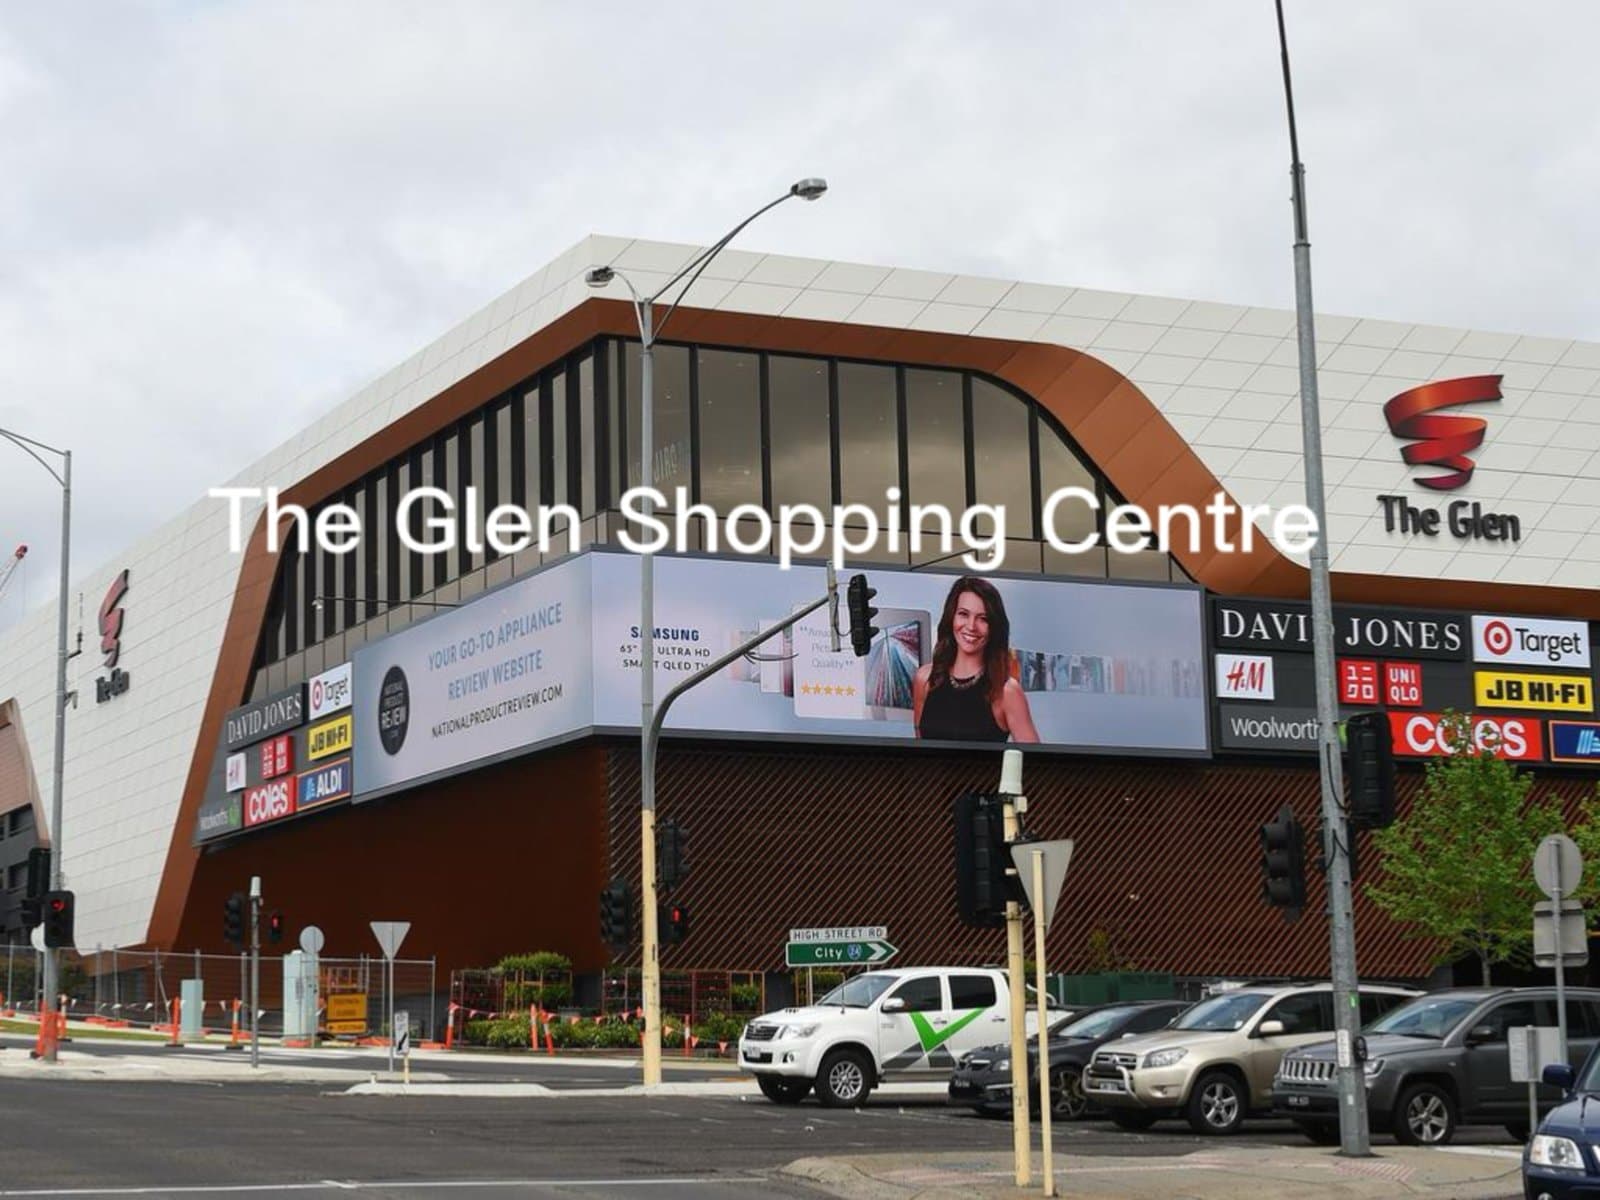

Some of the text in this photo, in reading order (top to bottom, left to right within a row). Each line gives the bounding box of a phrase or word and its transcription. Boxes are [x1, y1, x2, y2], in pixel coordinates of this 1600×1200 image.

[1377, 495, 1521, 542] The Glen
[429, 603, 562, 672] YOUR GO-TO APPLIANCE
[630, 626, 699, 642] SMSUNG
[1221, 609, 1462, 651] DAVI JONES
[1514, 628, 1582, 661] Target
[658, 646, 692, 657] ULTRA
[694, 648, 711, 657] HD
[663, 660, 692, 671] QLED
[448, 650, 543, 700] REVIEW WEBSITE
[1226, 661, 1266, 693] H&M
[1389, 668, 1416, 685] UNI
[1486, 679, 1524, 701] JB
[1390, 686, 1419, 703] QLO
[228, 692, 302, 744] DAVID JONES
[431, 684, 563, 738] NATIONALPRODUCTREVIEW.COM
[316, 768, 342, 798] ALDI
[250, 782, 289, 823] coles
[794, 926, 882, 940] HIGH STREET RD
[814, 947, 843, 960] City
